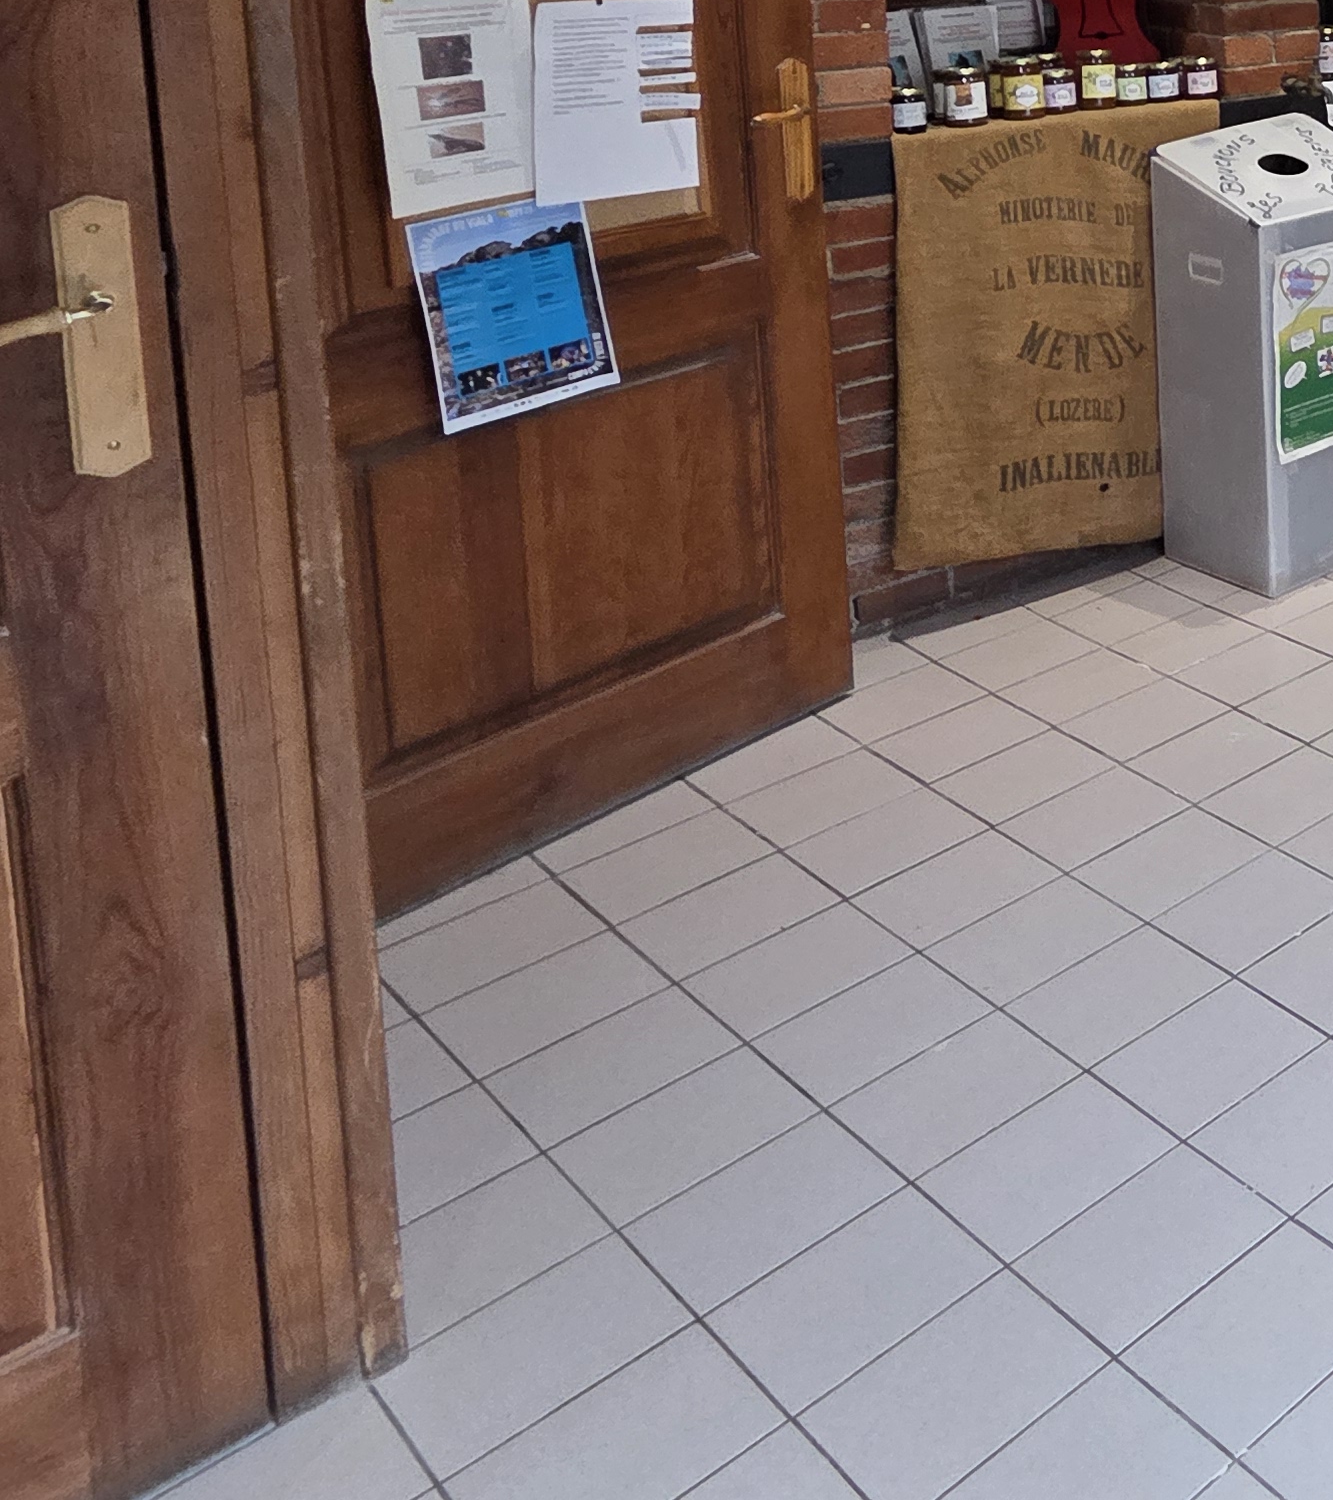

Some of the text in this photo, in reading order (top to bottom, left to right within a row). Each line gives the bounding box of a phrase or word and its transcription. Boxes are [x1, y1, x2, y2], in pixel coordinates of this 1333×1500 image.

[937, 128, 1047, 200] ALPHONSE
[998, 196, 1138, 226] MINOTERIE DE
[992, 254, 1145, 292] LA VERNEDE
[1016, 320, 1147, 374] MENDE
